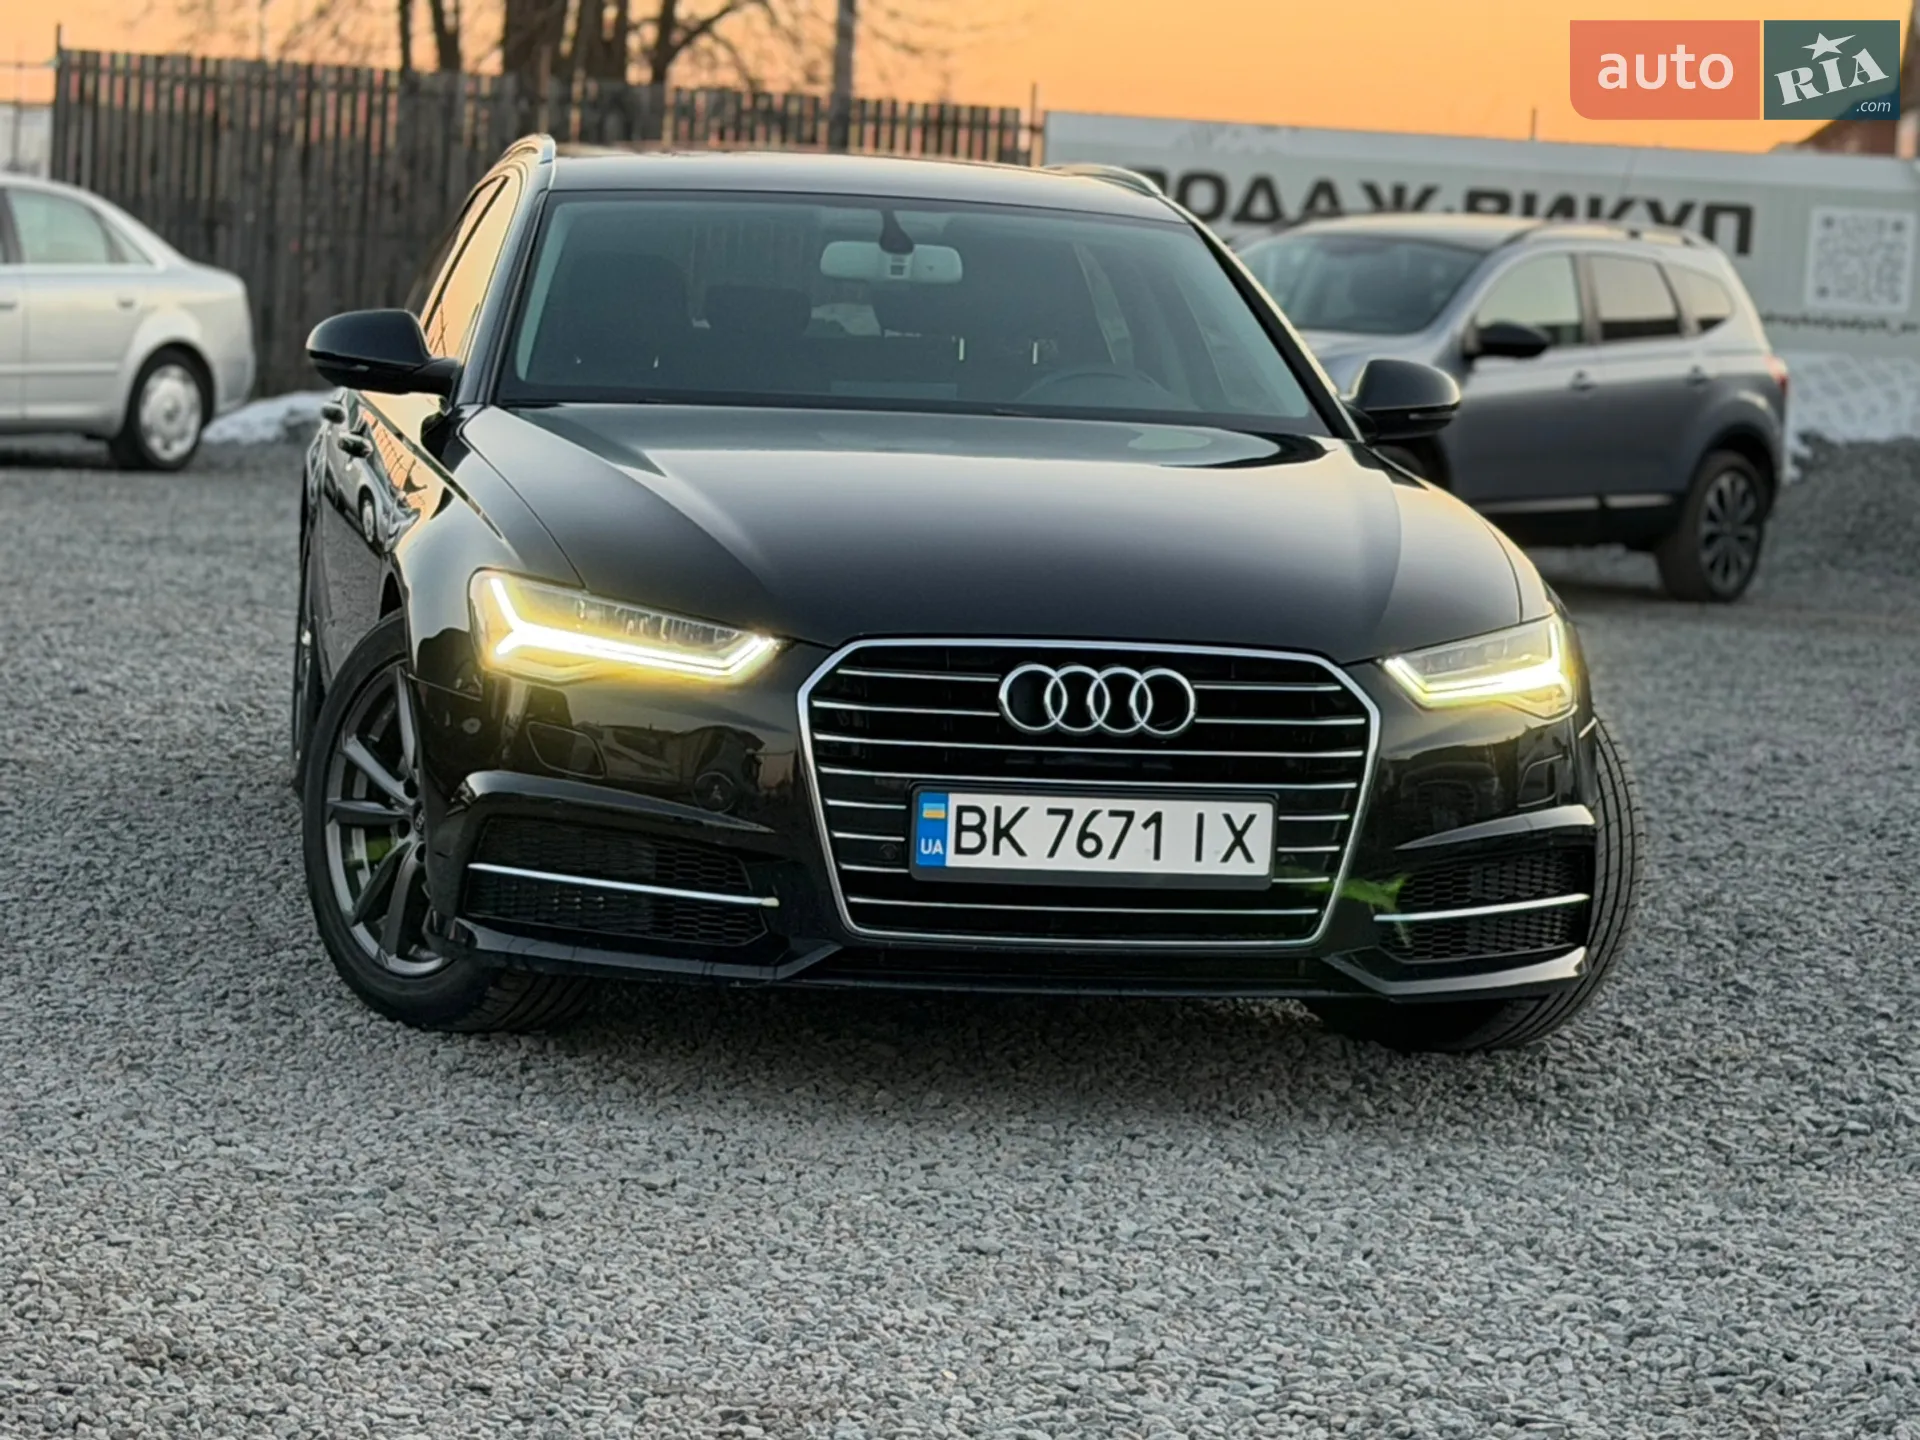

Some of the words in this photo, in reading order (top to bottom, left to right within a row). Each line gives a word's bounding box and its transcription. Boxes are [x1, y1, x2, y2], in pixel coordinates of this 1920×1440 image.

[920, 838, 944, 855] UA
[953, 804, 1031, 858] BK
[1045, 808, 1164, 862] 7671
[1194, 811, 1259, 864] IX
